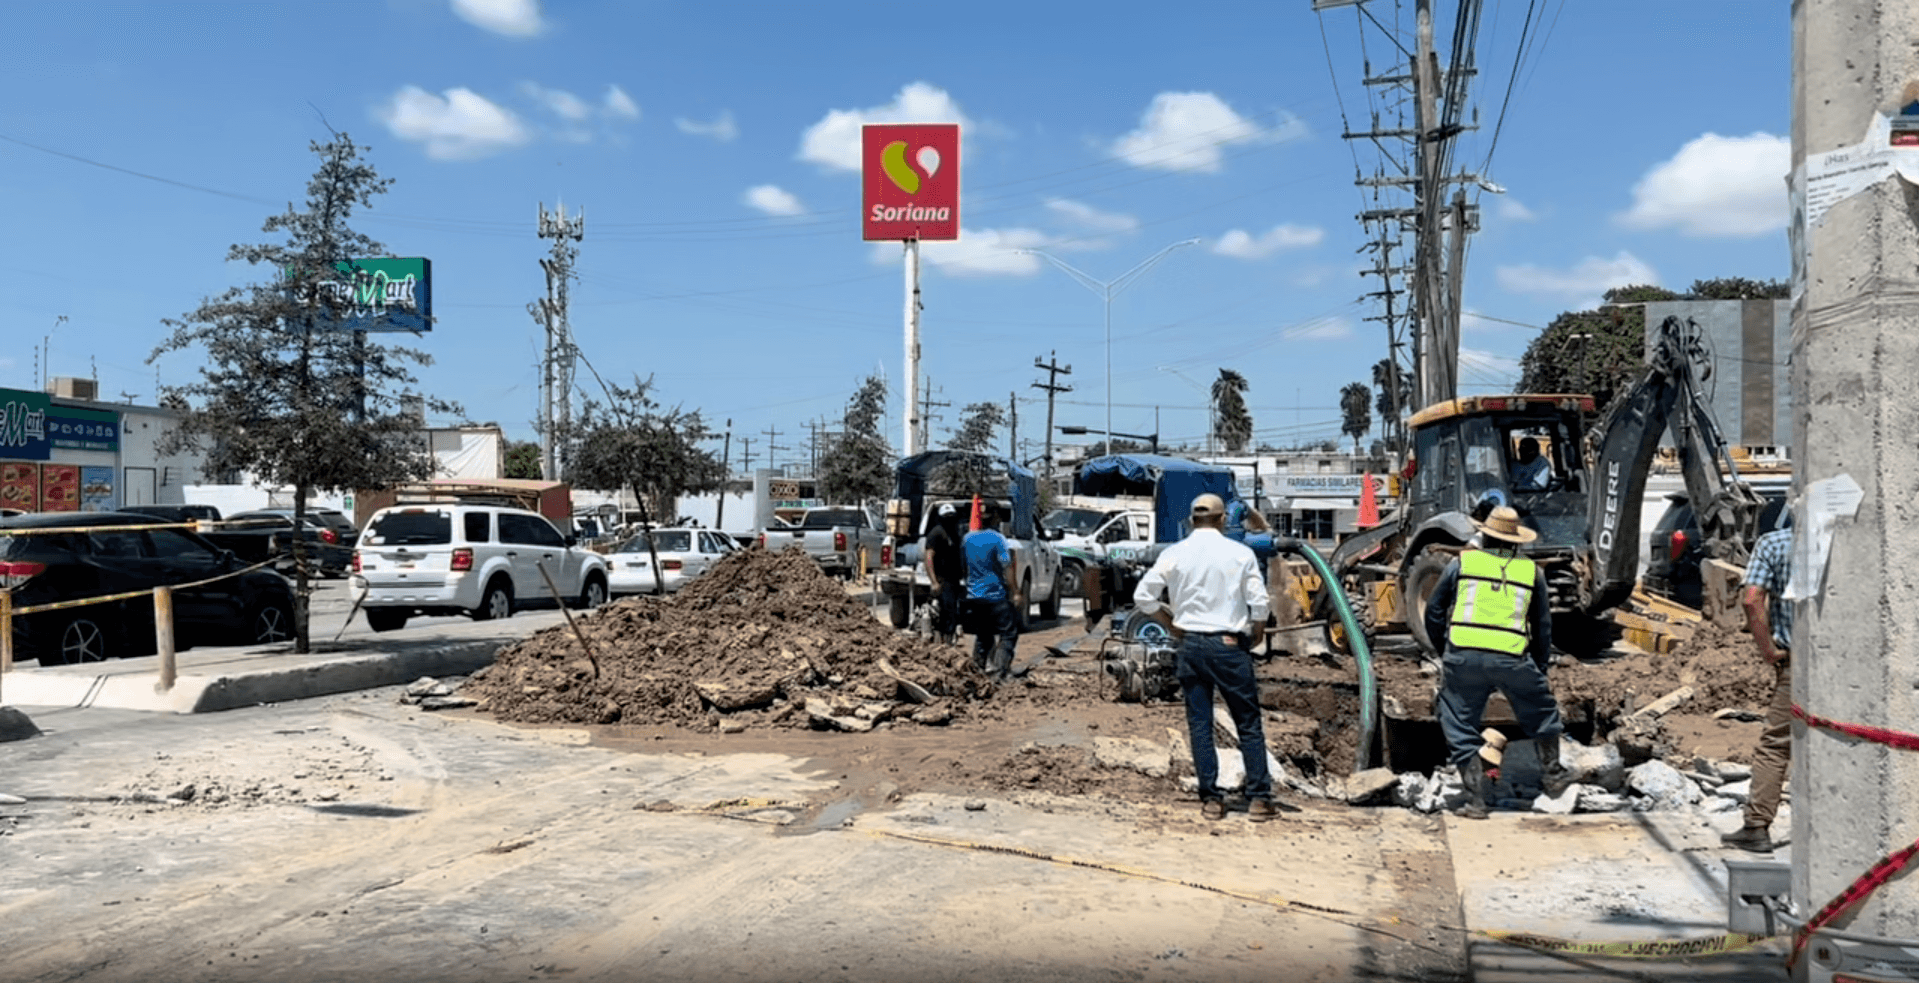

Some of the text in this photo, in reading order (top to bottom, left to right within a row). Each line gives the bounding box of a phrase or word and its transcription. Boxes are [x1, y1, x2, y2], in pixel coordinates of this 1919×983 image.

[870, 202, 951, 222] Soriana
[769, 483, 799, 497] OXXO
[1287, 477, 1326, 487] FARMACIAS
[1599, 461, 1620, 550] DEERE
